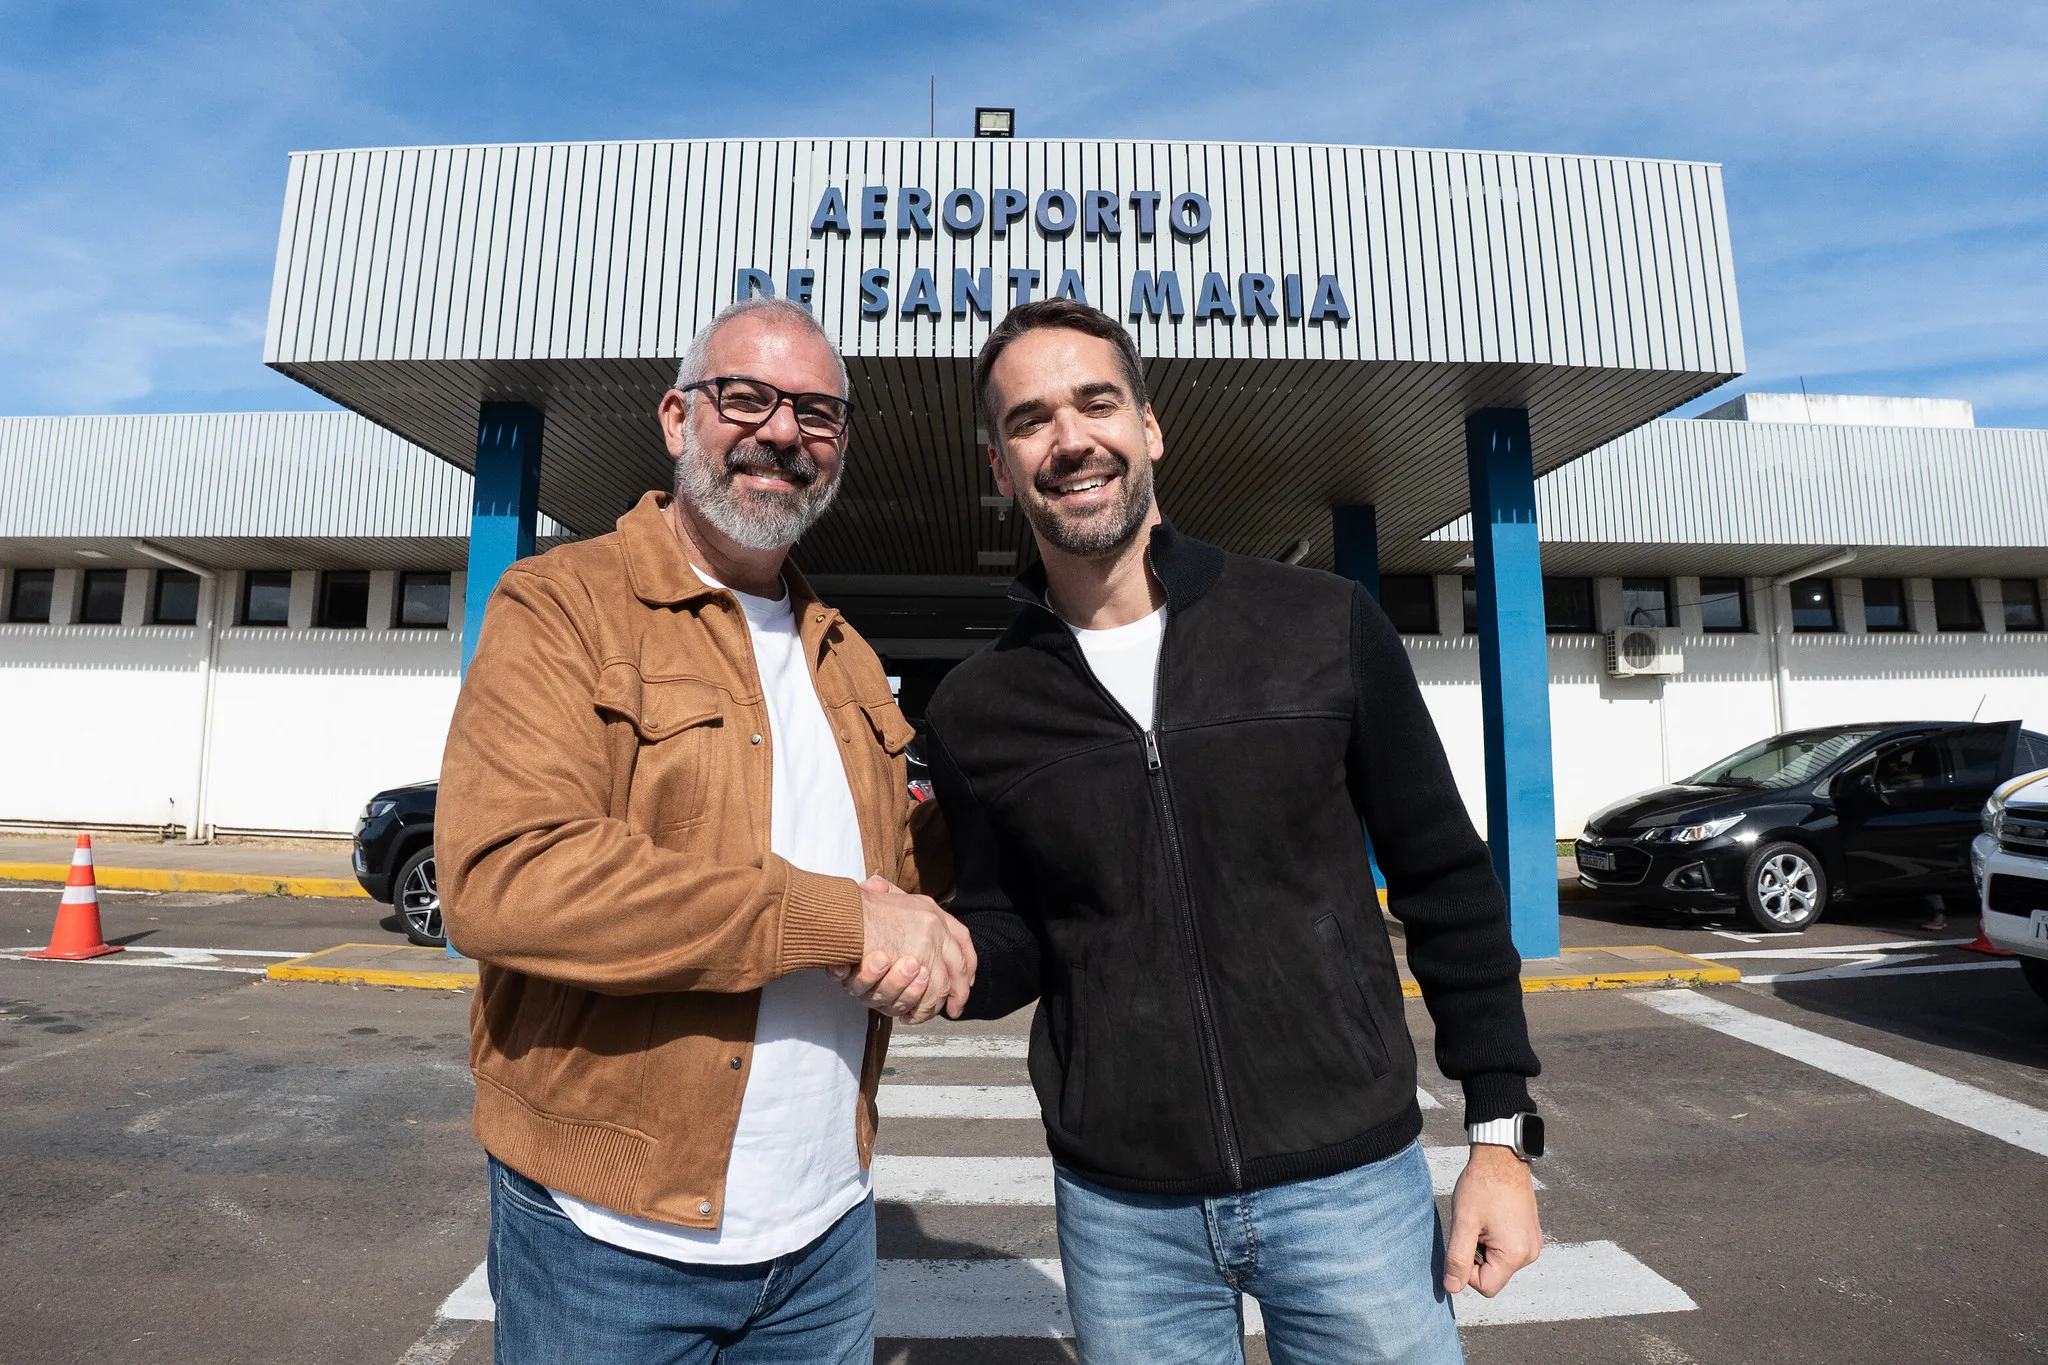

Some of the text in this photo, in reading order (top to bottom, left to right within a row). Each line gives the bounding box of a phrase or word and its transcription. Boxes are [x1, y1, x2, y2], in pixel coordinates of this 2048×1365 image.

[810, 186, 1212, 237] AEROPORTO
[737, 267, 1351, 321] DE SANTA MARIA
